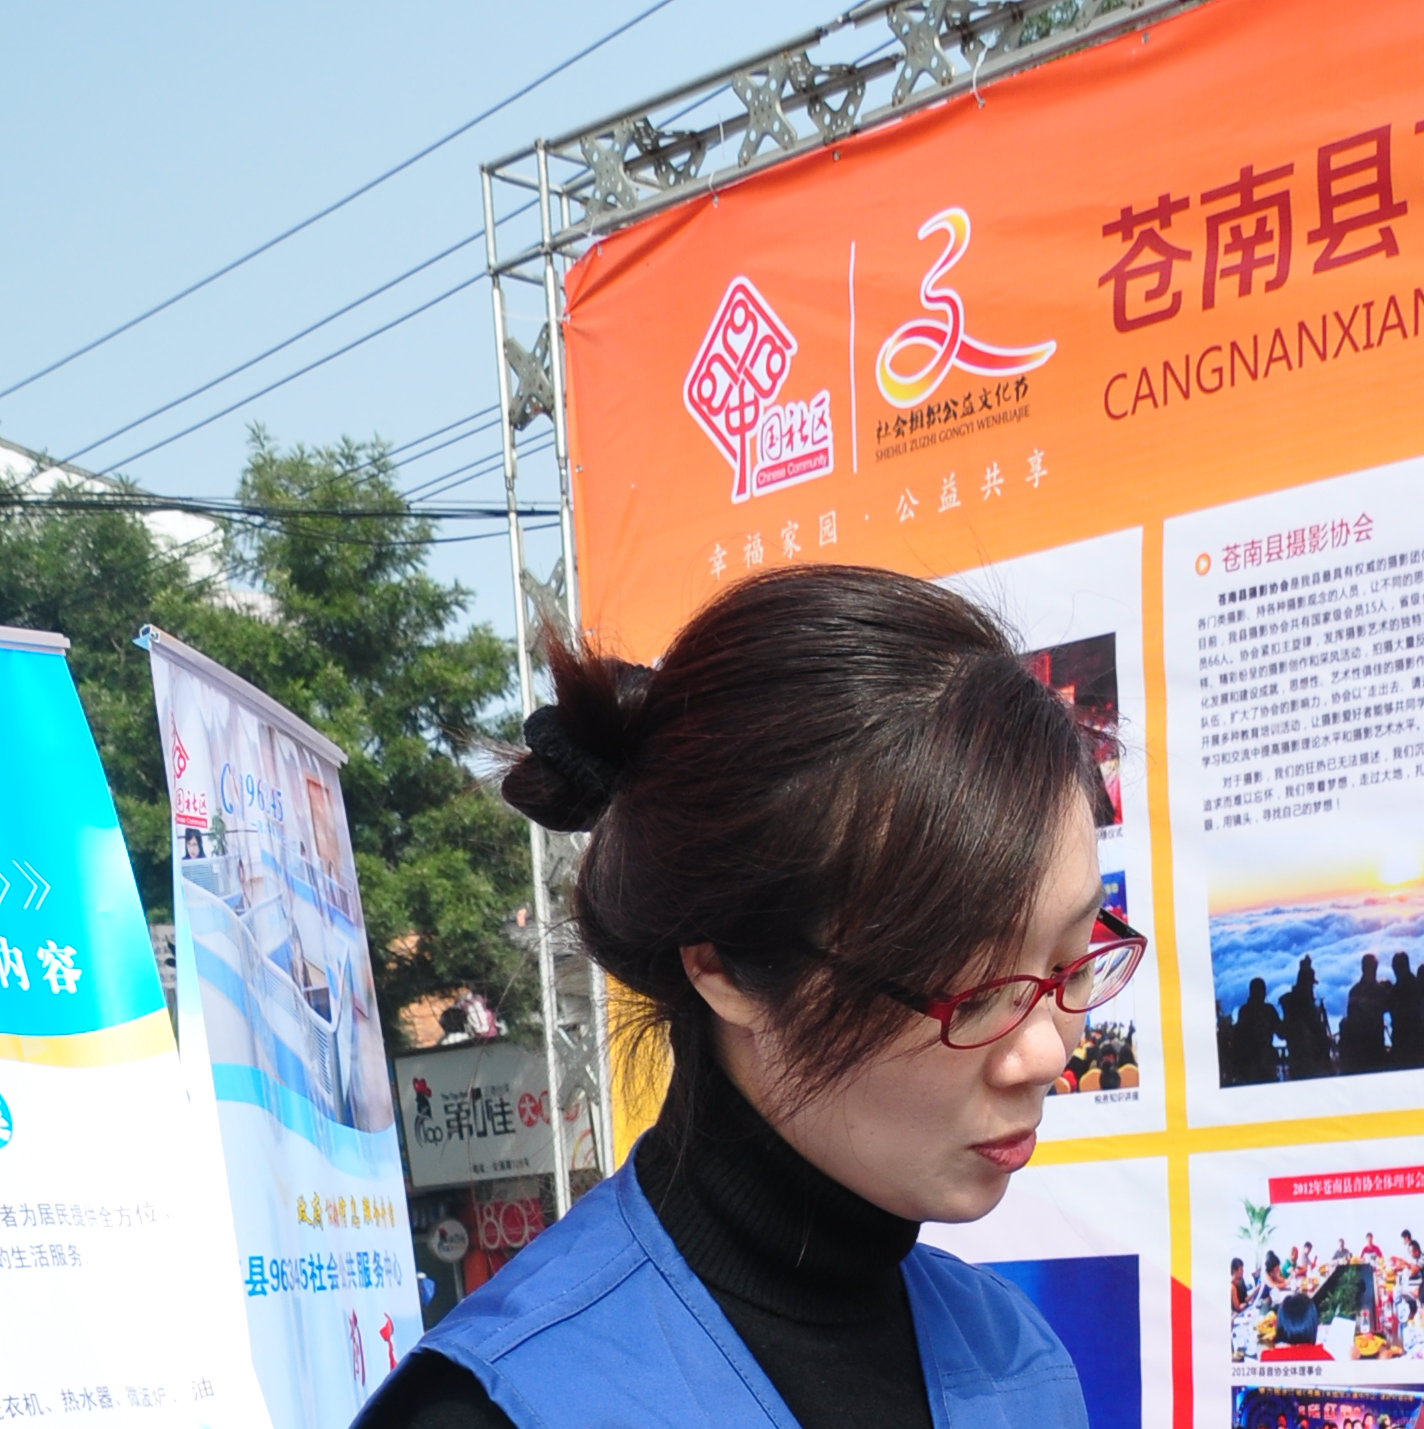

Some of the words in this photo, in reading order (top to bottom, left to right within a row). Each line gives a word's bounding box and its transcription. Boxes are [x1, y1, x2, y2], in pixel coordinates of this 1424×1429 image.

[1221, 512, 1374, 574] 苍南县摄影协会
